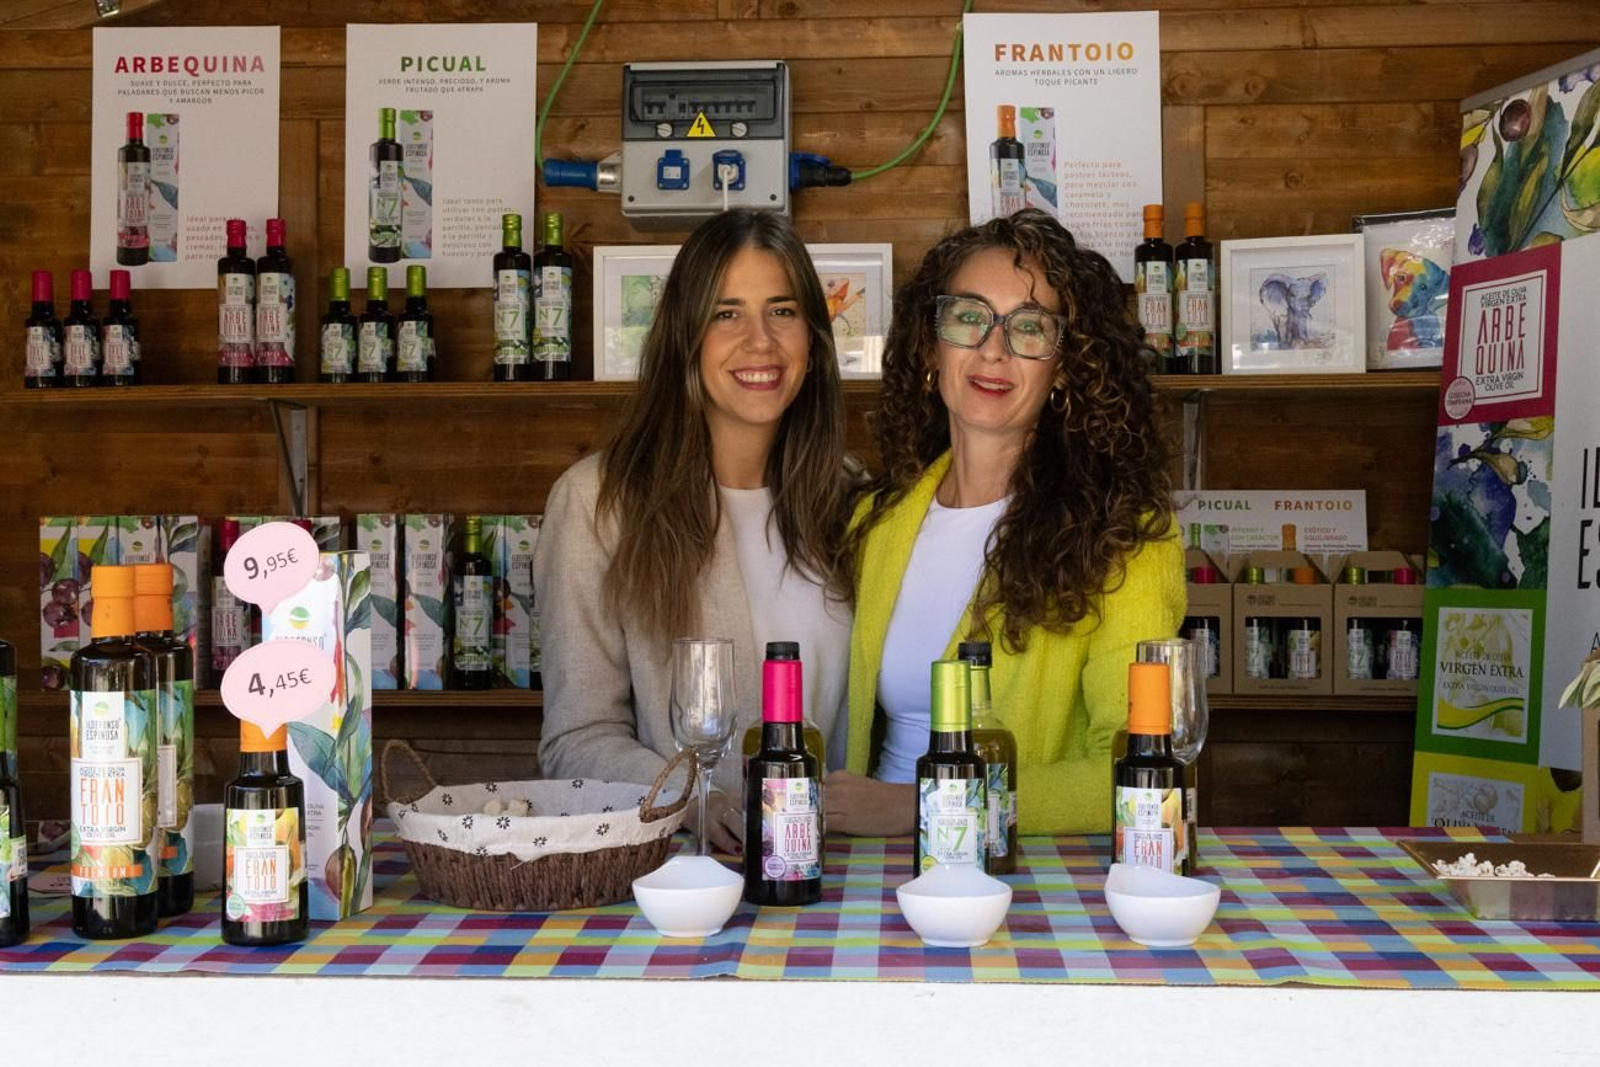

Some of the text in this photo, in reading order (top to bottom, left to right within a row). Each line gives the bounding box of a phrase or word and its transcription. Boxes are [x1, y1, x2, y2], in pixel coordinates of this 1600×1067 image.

[994, 42, 1134, 62] FRANTOIO
[114, 56, 265, 77] ARBEQUINA
[400, 56, 487, 72] PICUAL
[995, 69, 1028, 77] AROMAS
[1030, 69, 1072, 77] HERBALES
[1108, 68, 1138, 76] LIGERO
[163, 80, 189, 88] DULCE,
[378, 78, 401, 86] VERDE
[403, 78, 436, 86] INTENSO,
[439, 78, 478, 86] PRECIOSO,
[486, 77, 511, 85] AROMA
[1034, 78, 1098, 87] TOQUE PICANTE
[117, 87, 264, 97] PALADARES QUE BUSCAN MENOS PICOR
[405, 86, 439, 94] FRUTADO
[440, 86, 455, 94] QUE
[486, 198, 503, 206] para
[1480, 294, 1527, 308] VIRGEN EXTRA
[1481, 286, 1527, 301] ACEITE DE OLIVA
[1477, 302, 1527, 345] ARBE
[1475, 339, 1525, 375] QUINA
[1475, 375, 1500, 386] EXTRA
[1501, 371, 1524, 382] VIRGIN
[1484, 381, 1516, 391] OLIVE OIL
[1198, 500, 1252, 510] PICUAL
[1273, 500, 1354, 510] FRANTOIO
[243, 548, 299, 580] 9,95€
[1440, 661, 1525, 679] VIRGEN EXTRA
[248, 668, 314, 698] 4,45€
[85, 729, 119, 741] ESPINOSA
[80, 778, 125, 804] FRAN
[80, 803, 125, 826] TOIO
[785, 822, 811, 839] ARBE
[785, 838, 811, 852] QUINA
[1134, 840, 1163, 855] FRAN
[245, 859, 277, 876] FRAN
[245, 876, 277, 891] TOIO
